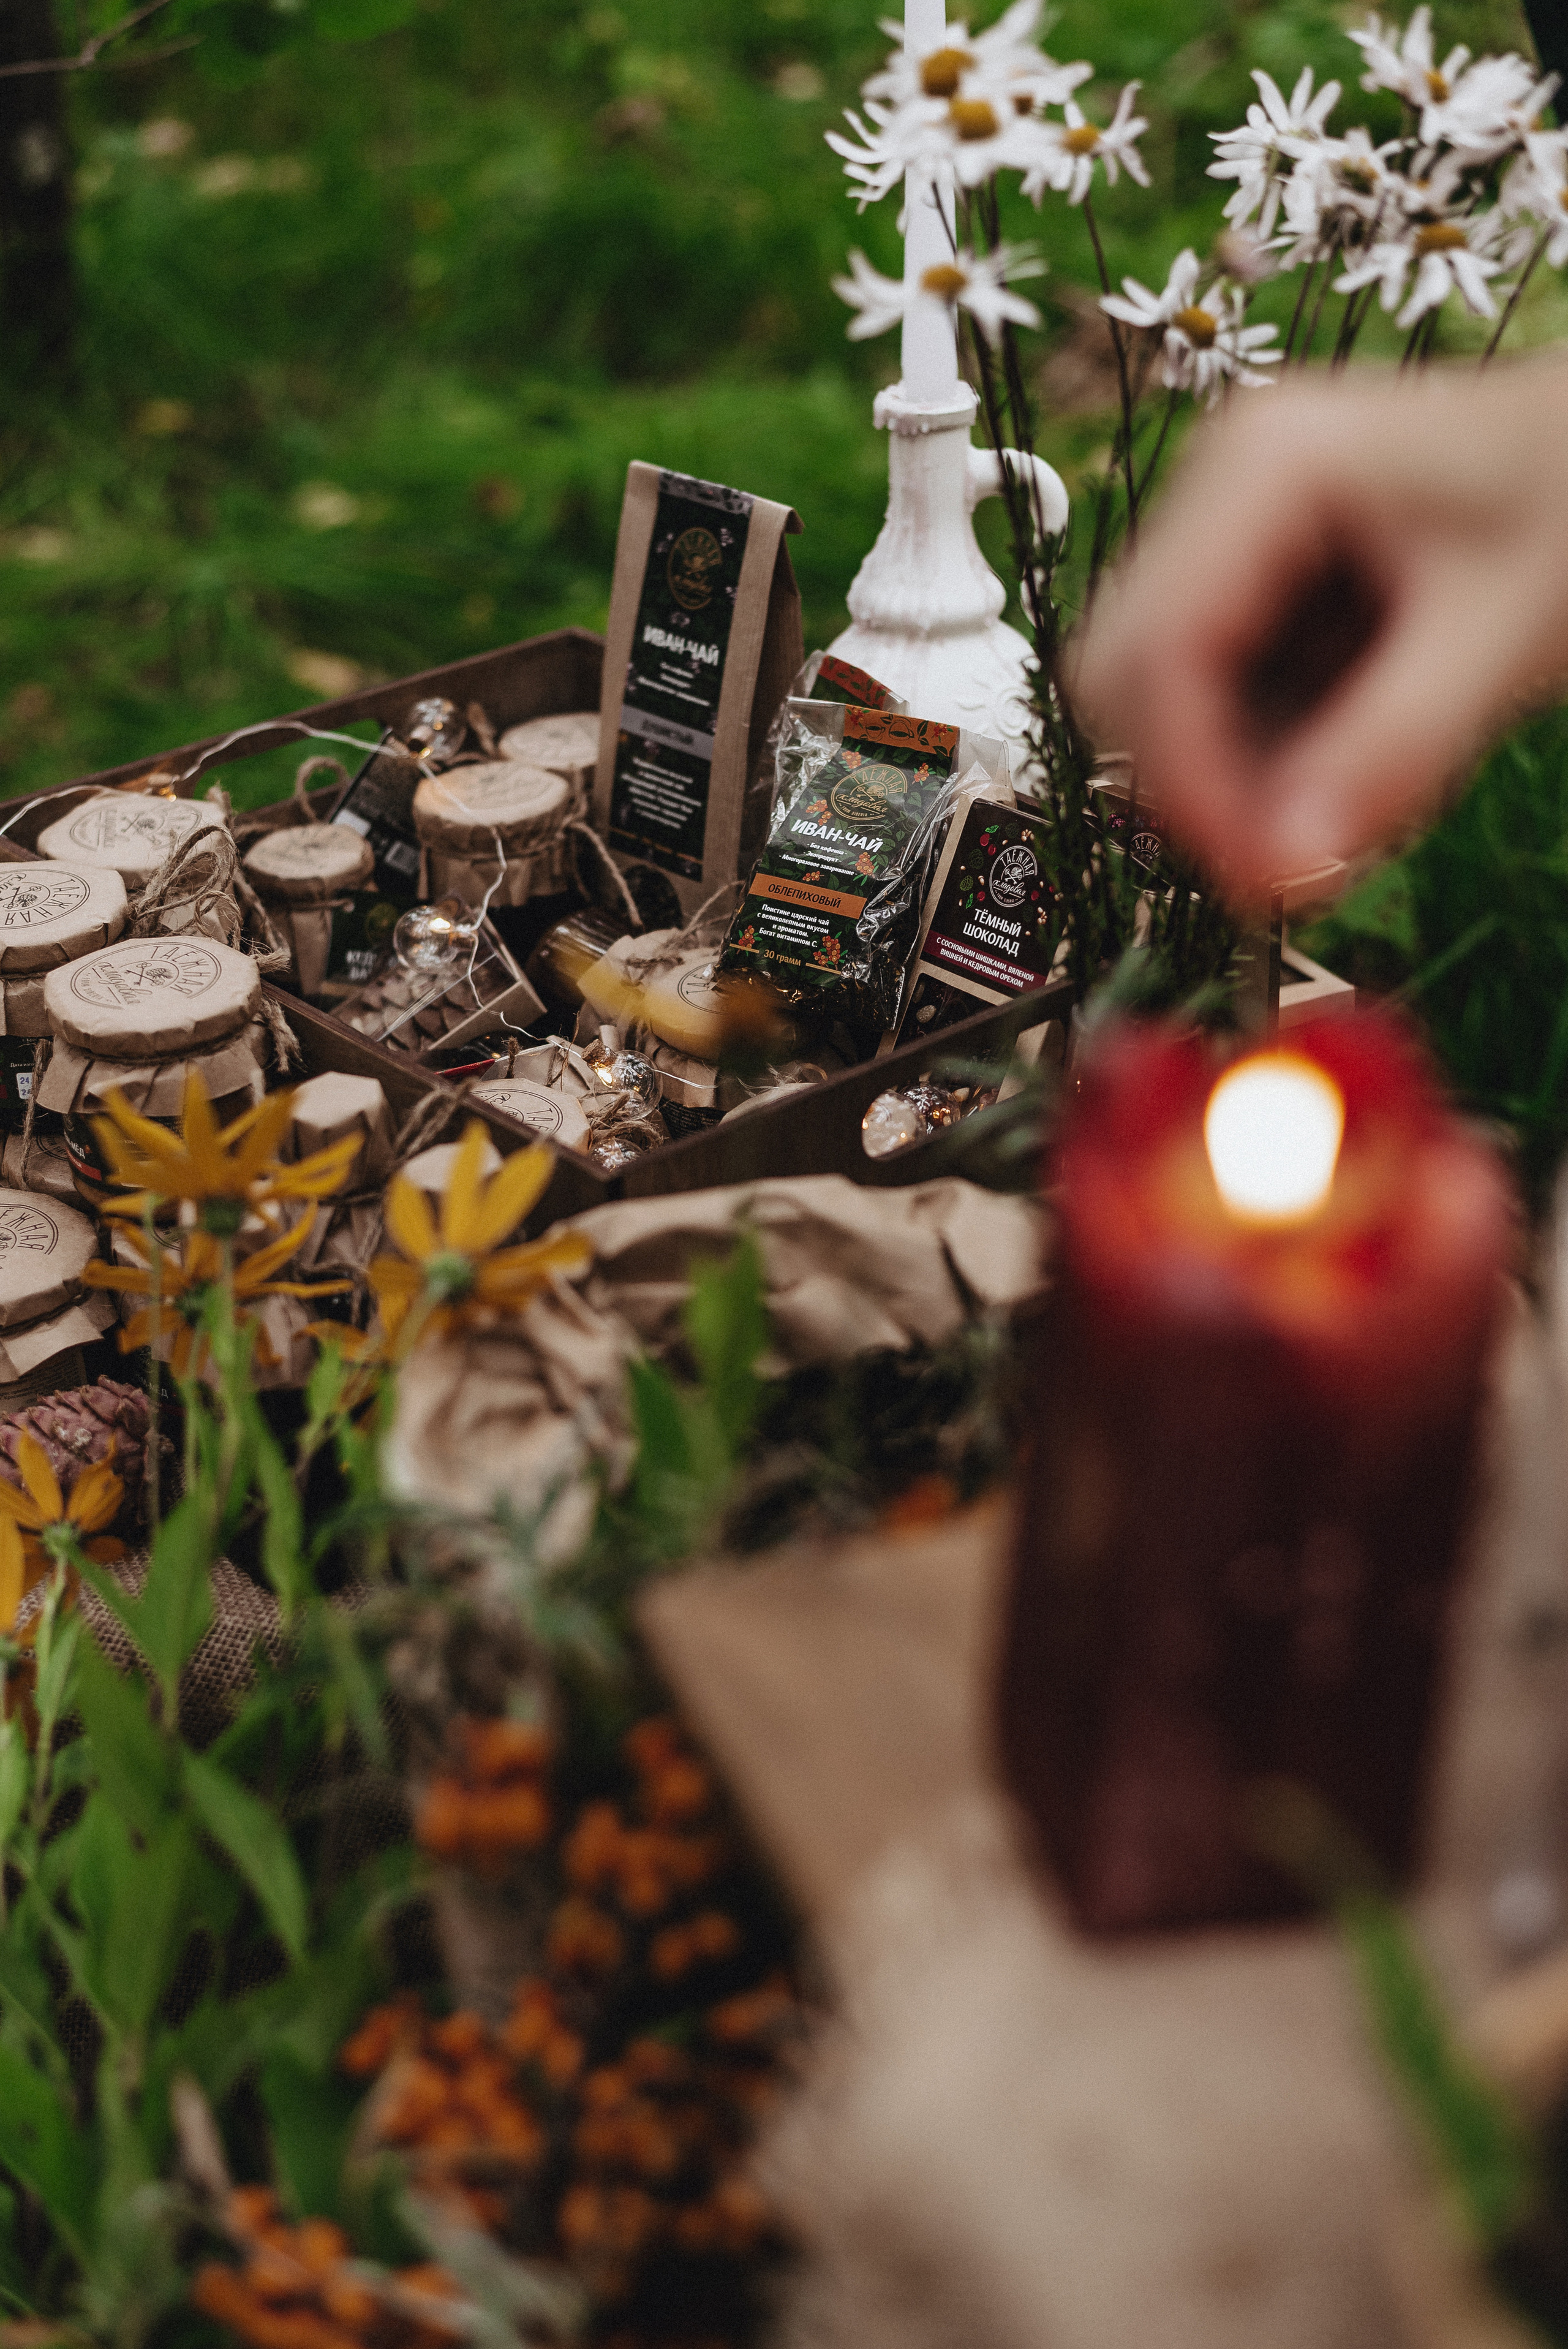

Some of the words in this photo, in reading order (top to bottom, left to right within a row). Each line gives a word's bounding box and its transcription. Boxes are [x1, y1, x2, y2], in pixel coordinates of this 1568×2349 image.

[644, 624, 719, 666] ИВАН-ЧАЙ
[791, 819, 883, 853] ИВАН-ЧАЙ
[806, 851, 839, 863] Экопродукт
[820, 845, 844, 855] кофеина
[782, 854, 820, 868] Многоразовое
[820, 864, 854, 876] заваривание
[768, 883, 842, 908] ОБЛЕПИХОВЫЙ
[761, 913, 805, 929] великолепным
[806, 924, 829, 934] вкусом
[762, 904, 791, 916] Поистине
[791, 912, 817, 923] царский
[974, 909, 1022, 937] ТЁМНЫЙ
[759, 927, 776, 937] Богат
[777, 933, 810, 946] витамином
[777, 925, 809, 937] ароматом.
[963, 922, 1020, 958] ШОКОЛАД
[764, 950, 775, 959] 30
[776, 953, 801, 966] грамм
[940, 948, 963, 963] ВИШНЕЙ
[968, 959, 1000, 978] КЕДРОВЫМ
[1000, 973, 1023, 988] ОРЕХОМ
[941, 939, 976, 958] СОСНОВЫМИ
[975, 953, 1008, 972] ШИШКАМИ,
[1008, 966, 1035, 982] ВЯЛЕНОЙ
